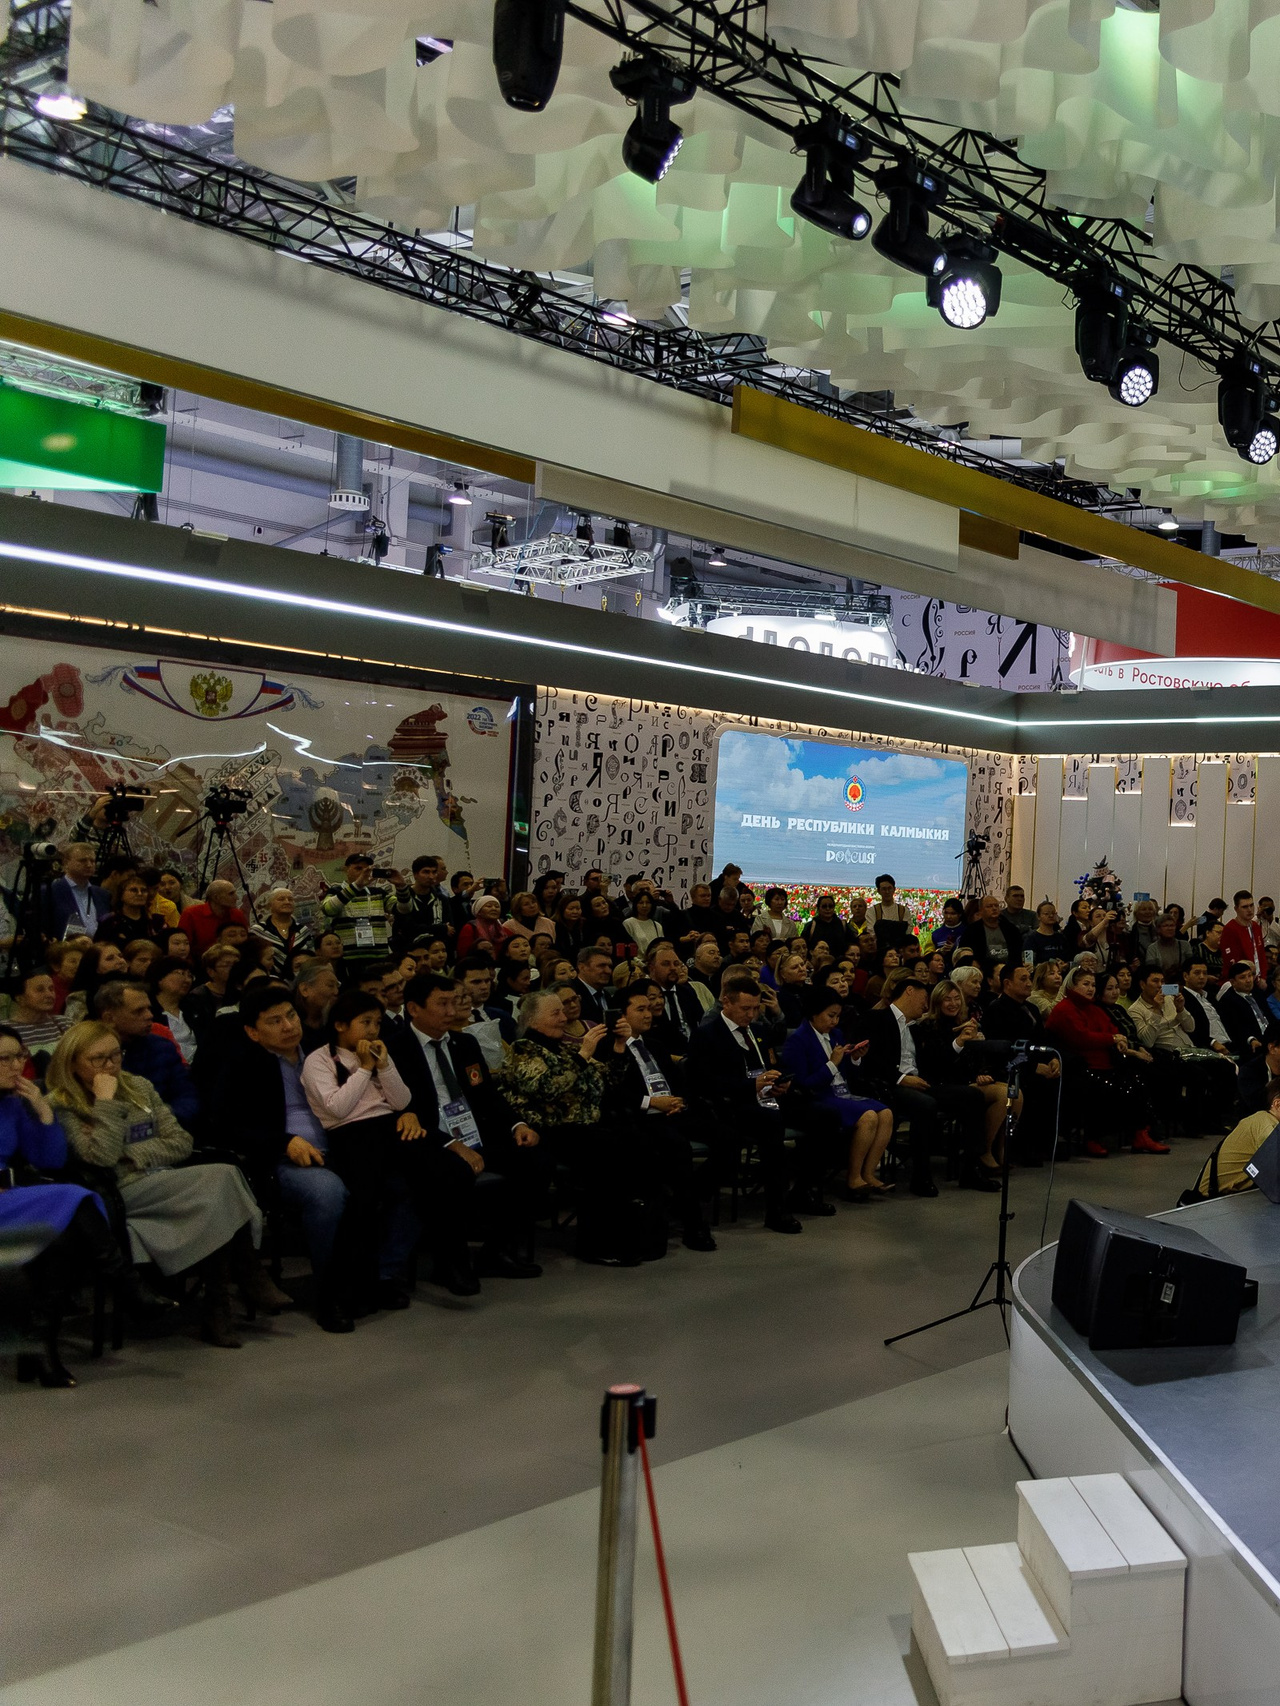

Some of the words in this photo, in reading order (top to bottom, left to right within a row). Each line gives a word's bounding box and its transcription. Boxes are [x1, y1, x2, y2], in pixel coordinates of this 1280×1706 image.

[741, 814, 781, 829] ДЕНЬ
[787, 817, 875, 836] РЕСПУБЛИКИ
[880, 824, 950, 841] КАЛМЫКИЯ
